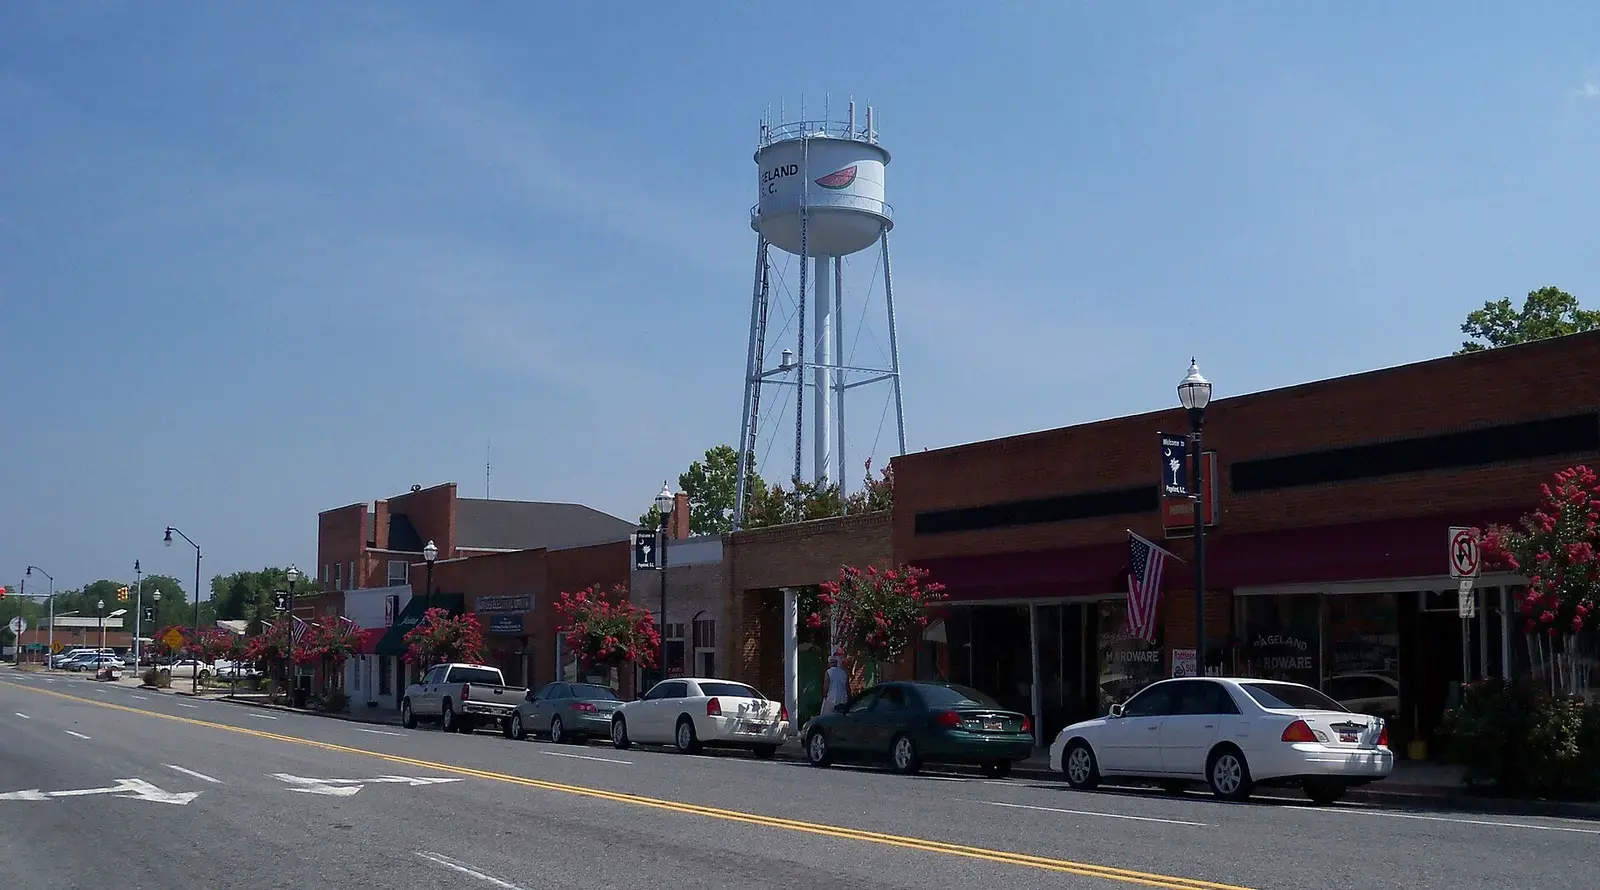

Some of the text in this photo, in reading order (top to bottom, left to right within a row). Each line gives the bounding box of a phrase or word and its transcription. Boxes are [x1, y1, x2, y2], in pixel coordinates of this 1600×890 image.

[1162, 438, 1180, 447] Welcome
[1252, 634, 1308, 651] PAGELAND
[1106, 650, 1160, 663] HARDWARE
[1252, 656, 1313, 669] ARDWARE
